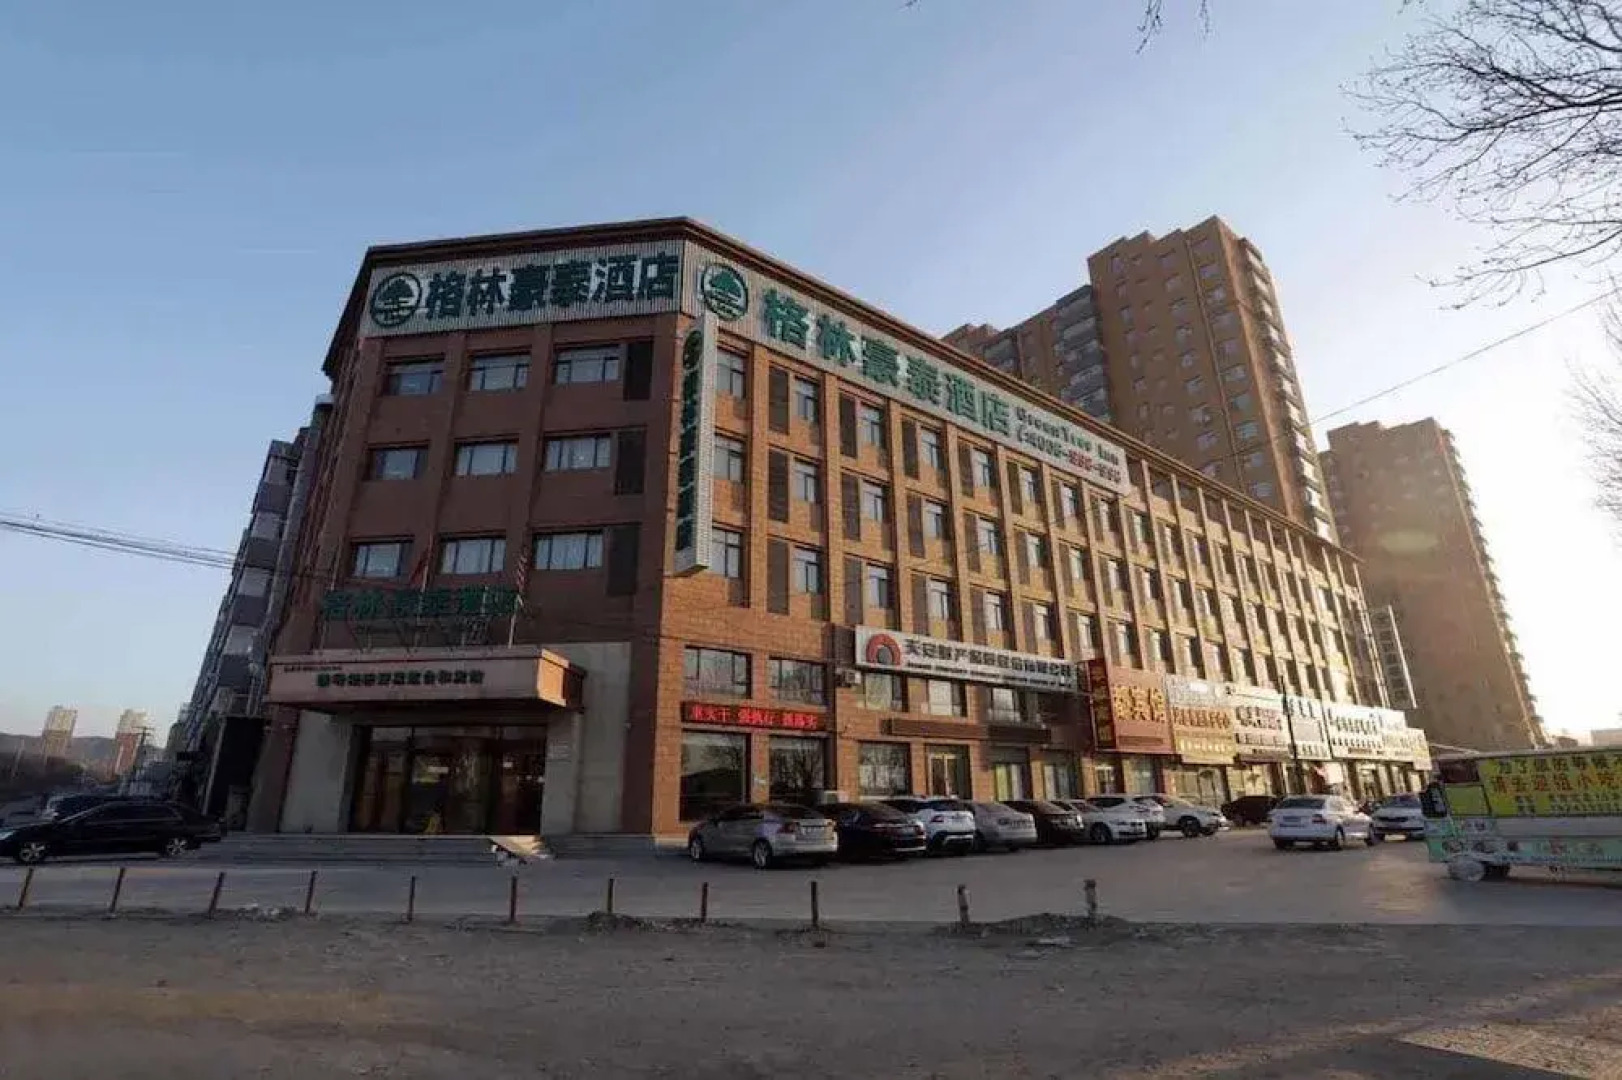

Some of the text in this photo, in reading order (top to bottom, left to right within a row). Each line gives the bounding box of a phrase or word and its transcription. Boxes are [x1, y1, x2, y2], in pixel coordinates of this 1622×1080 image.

[425, 252, 679, 320] 格林豪泰酒店
[763, 288, 1011, 438] 格林豪泰酒店
